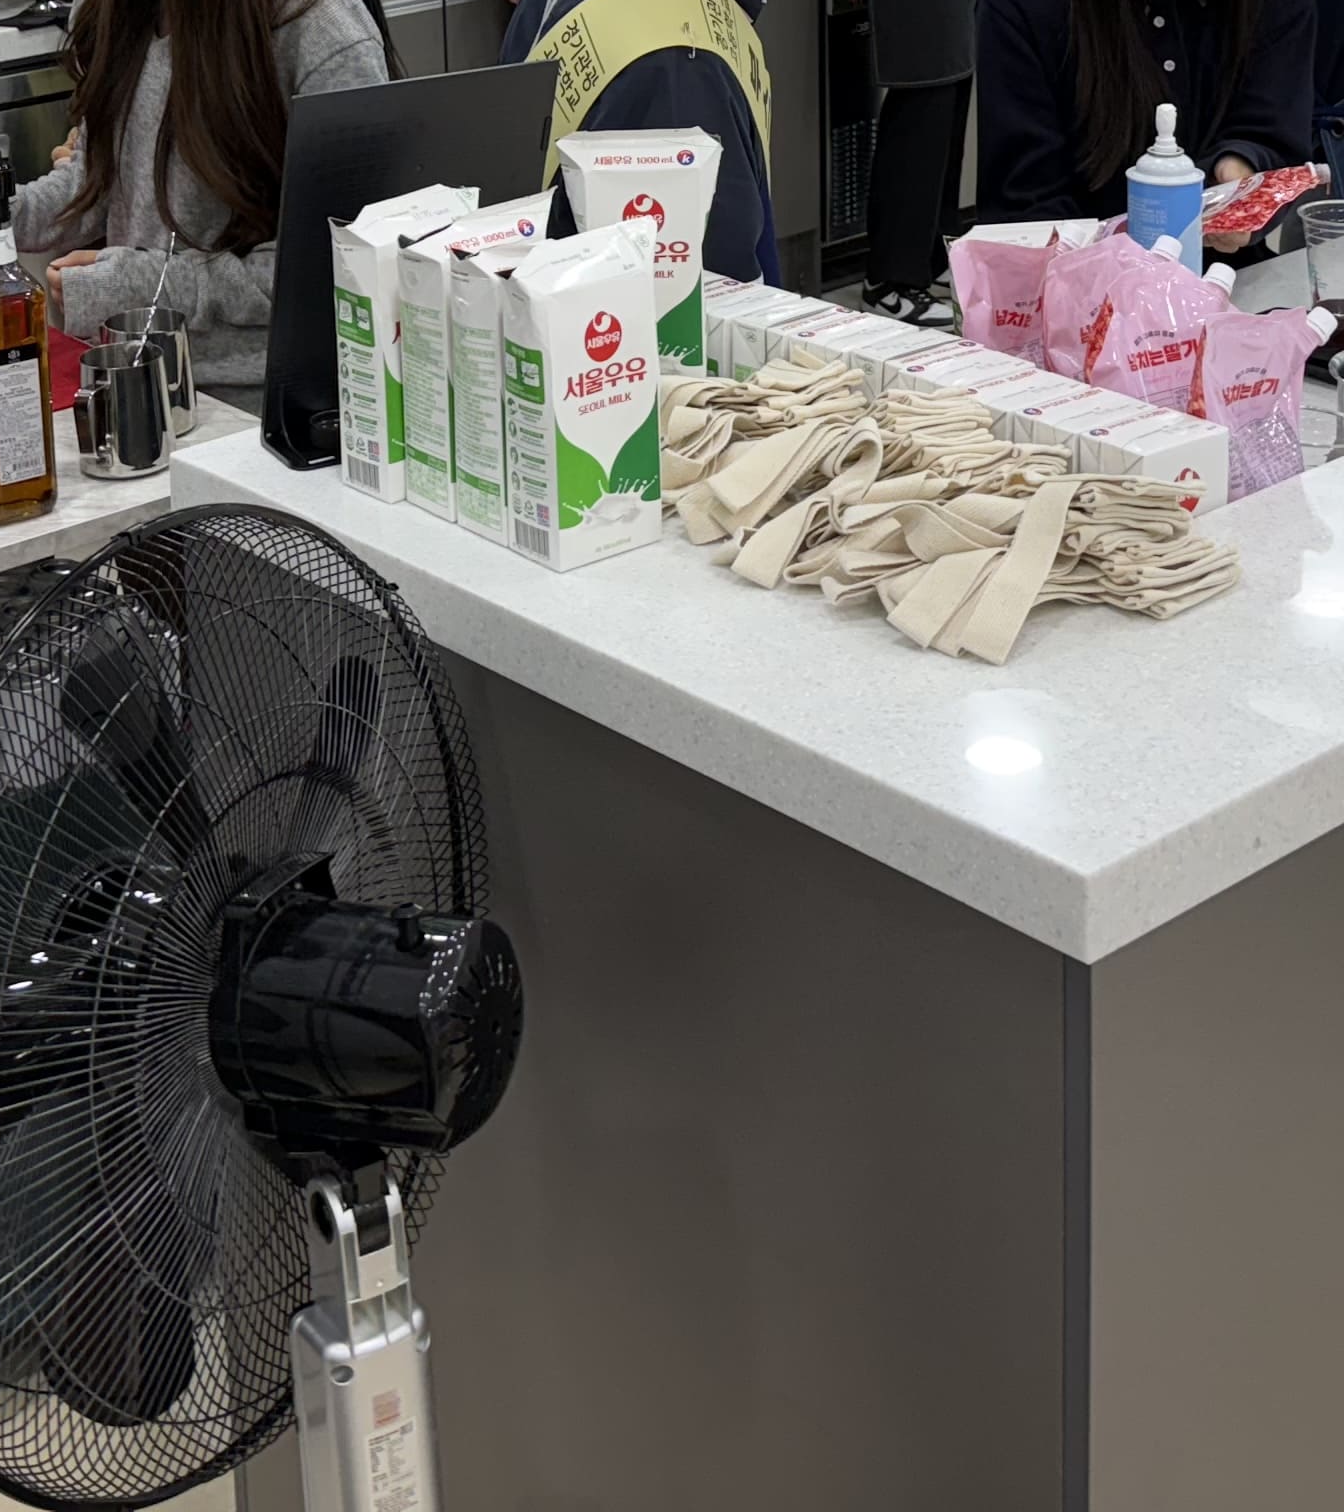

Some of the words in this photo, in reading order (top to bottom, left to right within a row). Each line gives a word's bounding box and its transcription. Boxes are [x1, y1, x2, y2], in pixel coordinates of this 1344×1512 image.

[561, 18, 600, 92] 경기관광
[1127, 338, 1200, 374] 넘치는딸기
[563, 357, 648, 402] 서울우유
[577, 400, 608, 416] SEOUL
[608, 391, 632, 406] MILK
